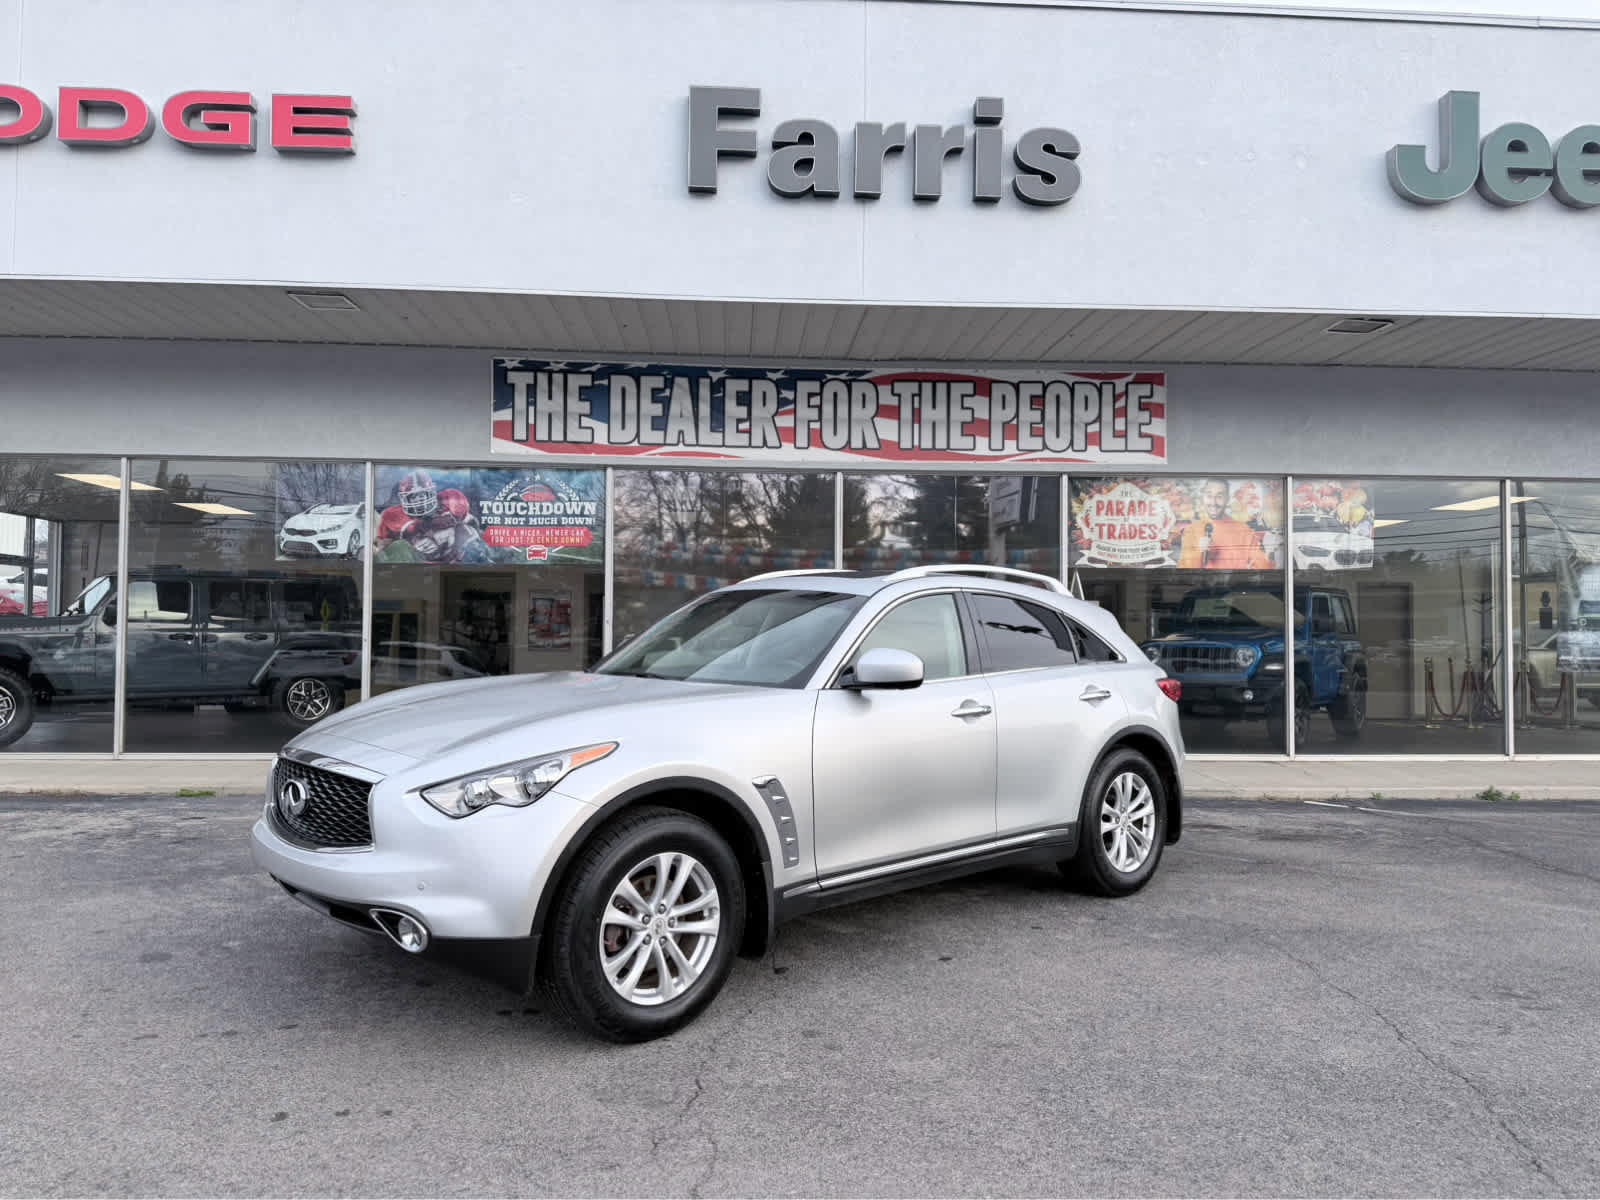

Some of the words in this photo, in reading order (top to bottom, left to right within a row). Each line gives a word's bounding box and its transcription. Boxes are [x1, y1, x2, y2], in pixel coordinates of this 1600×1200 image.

[687, 85, 1081, 206] Farris
[506, 370, 594, 444] THE
[607, 374, 782, 448] DEALER
[793, 377, 881, 451] FOR
[891, 380, 976, 451] THE
[988, 380, 1154, 452] PEOPLE
[480, 501, 596, 515] TOUCHDOWN
[1095, 500, 1158, 516] PARADE
[481, 516, 501, 525] FOR
[504, 516, 526, 525] NOT
[529, 516, 557, 525] MUCH
[561, 516, 596, 525] DOWN!
[1095, 523, 1159, 540] TRADES
